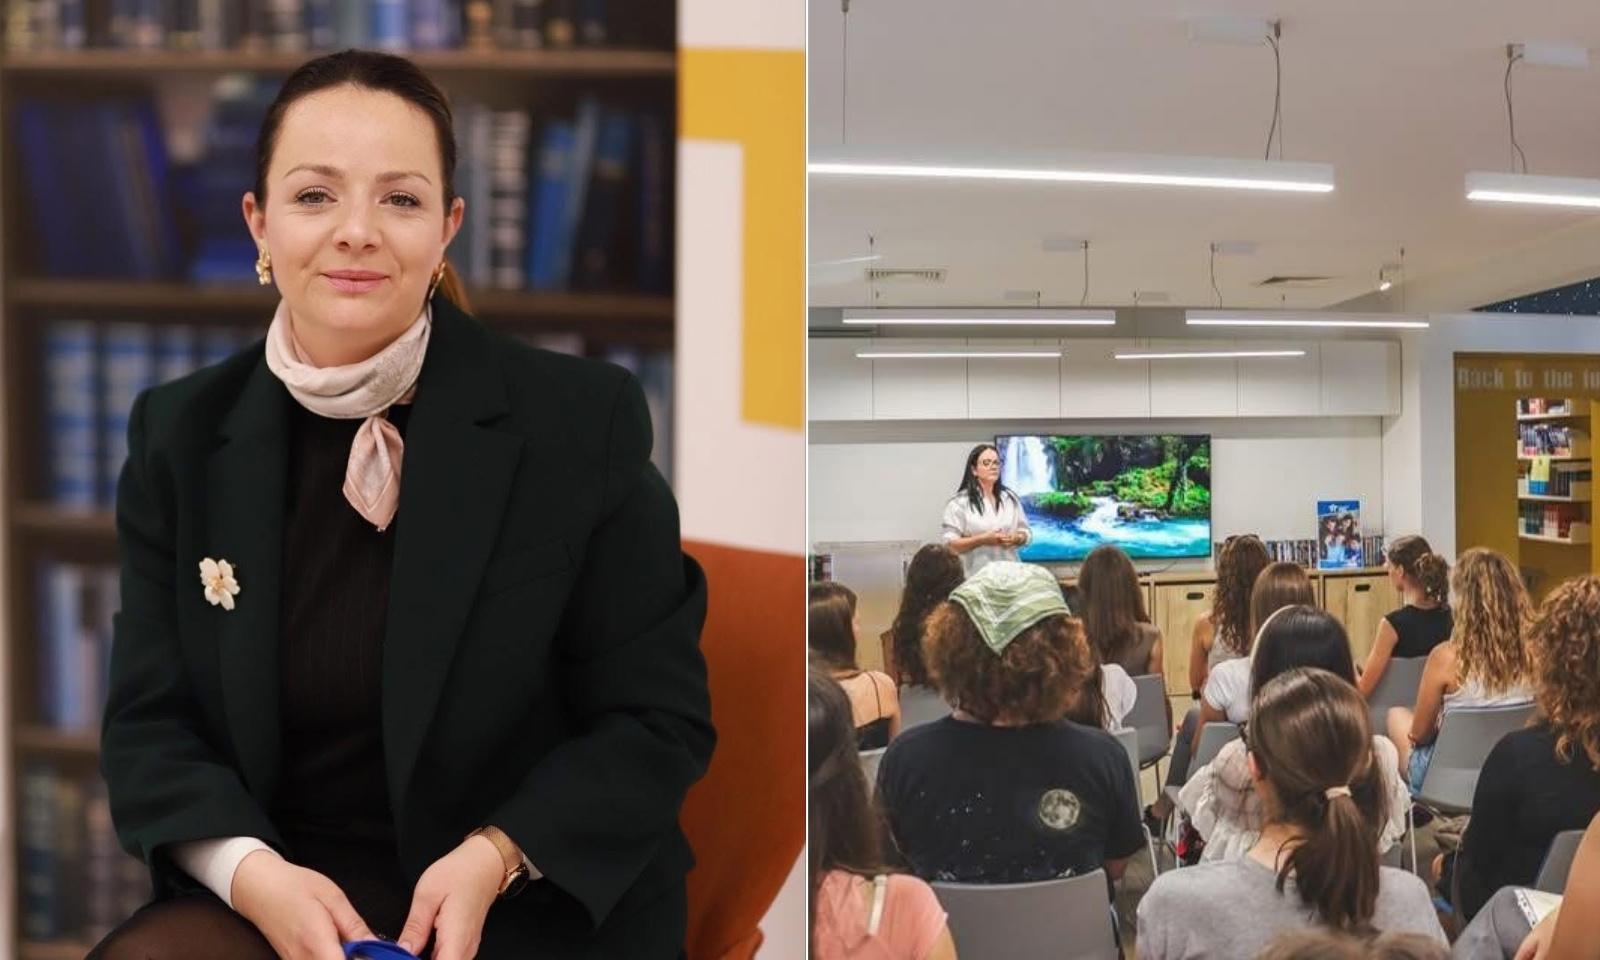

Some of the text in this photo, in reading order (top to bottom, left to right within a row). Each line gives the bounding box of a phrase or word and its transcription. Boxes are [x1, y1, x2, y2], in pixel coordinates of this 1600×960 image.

[1458, 367, 1504, 390] Back
[1515, 369, 1533, 389] to
[1544, 369, 1573, 389] the
